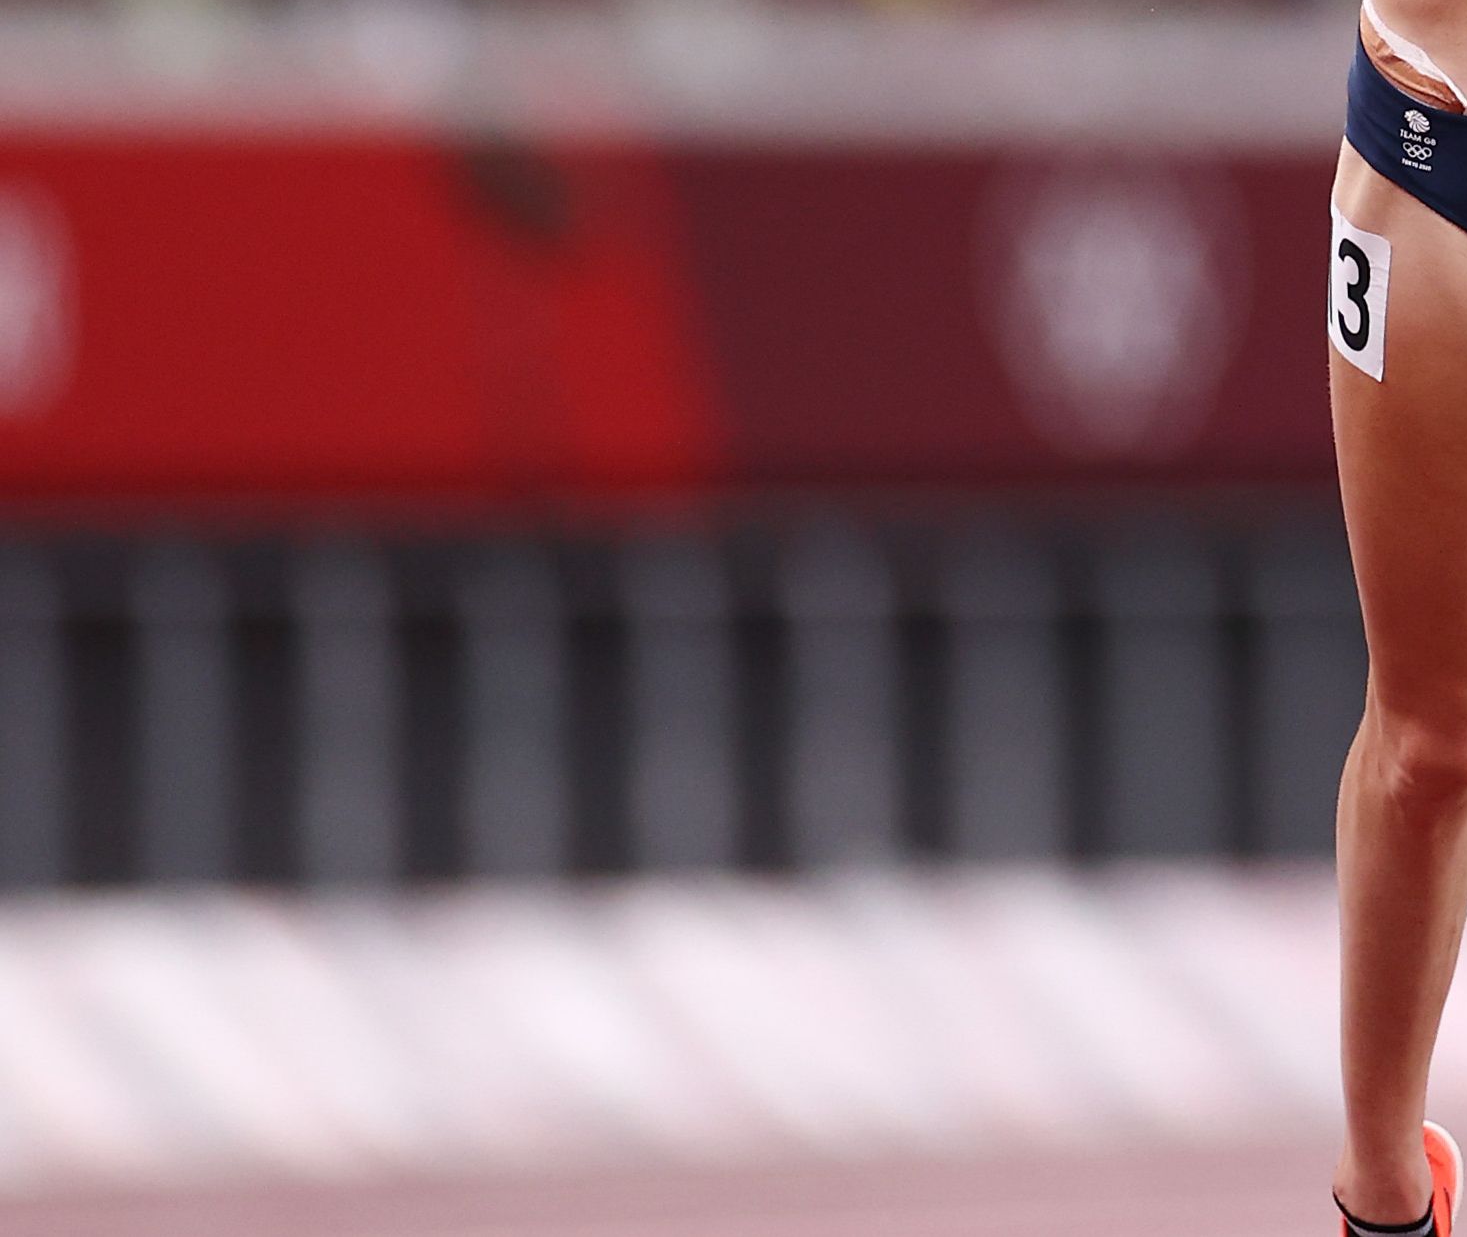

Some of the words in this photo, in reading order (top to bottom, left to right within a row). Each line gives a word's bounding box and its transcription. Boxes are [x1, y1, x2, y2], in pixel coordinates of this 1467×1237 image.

[1400, 128, 1422, 143] TEAM
[1423, 136, 1437, 147] GB
[1329, 237, 1371, 352] 3
